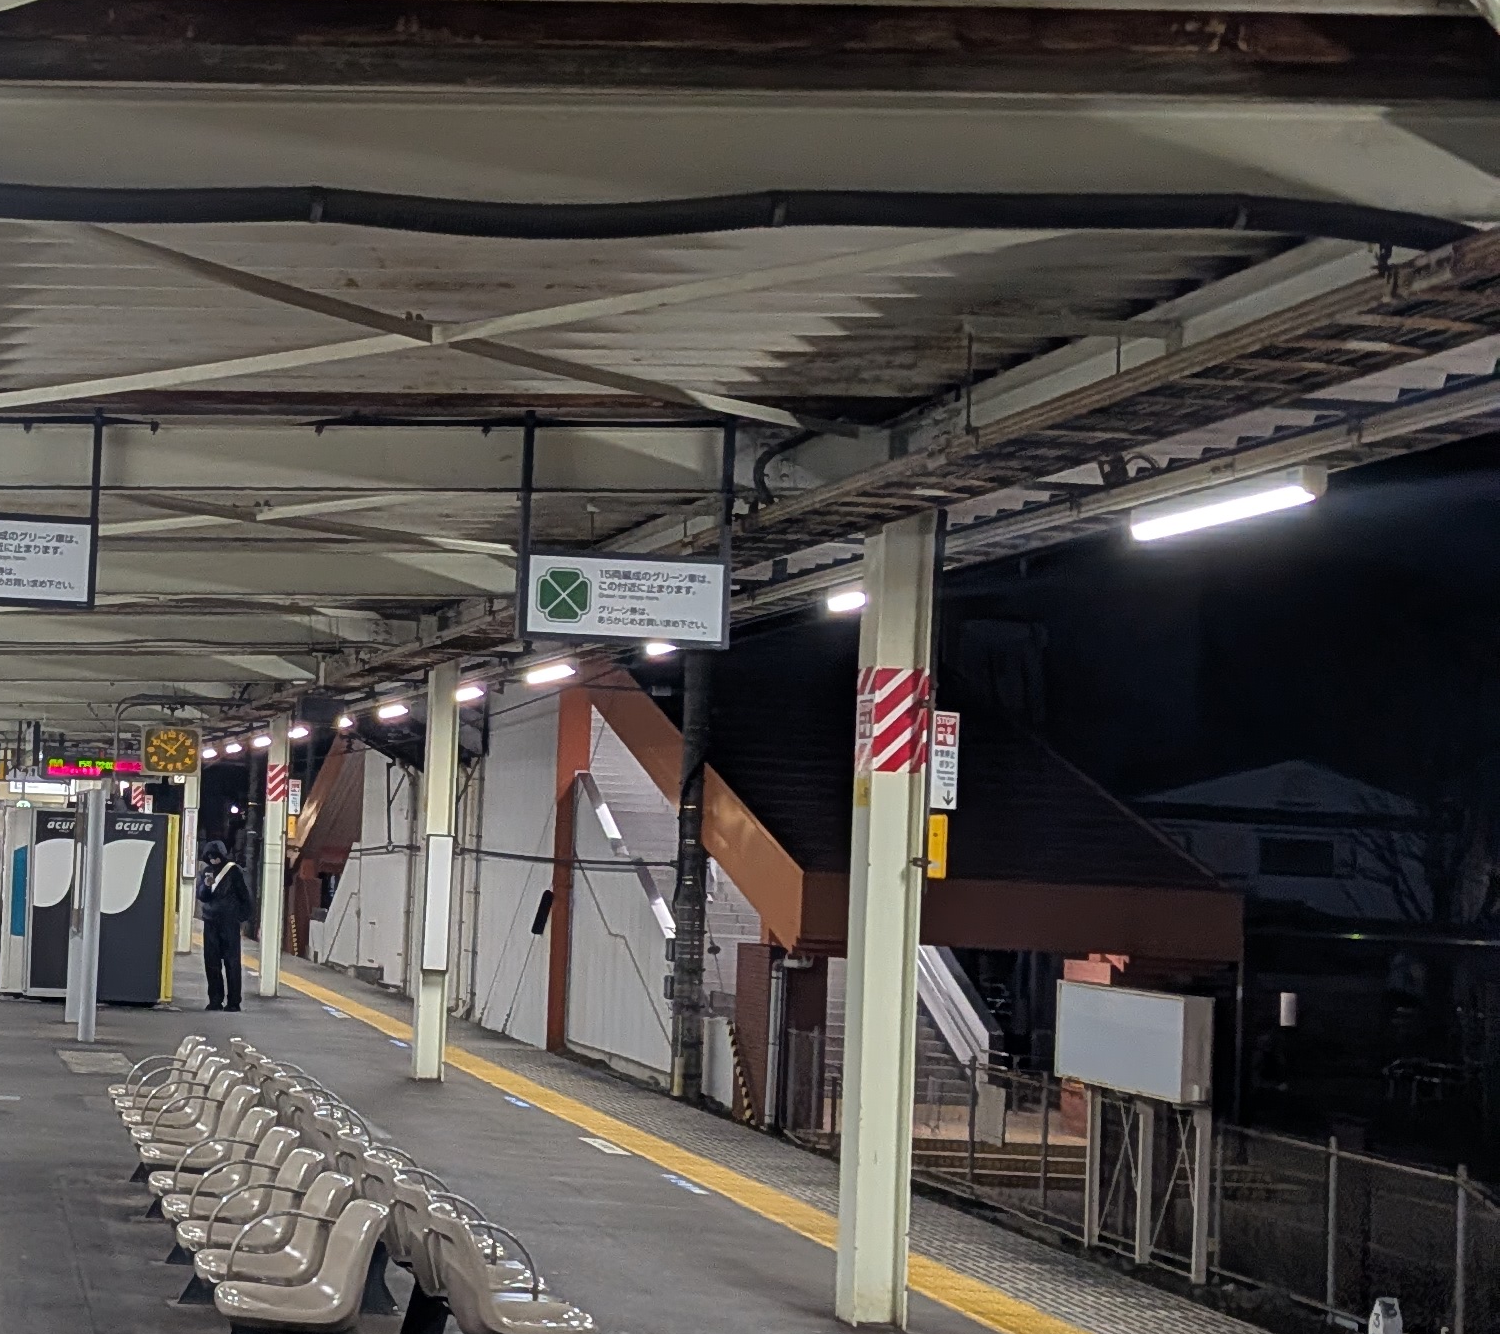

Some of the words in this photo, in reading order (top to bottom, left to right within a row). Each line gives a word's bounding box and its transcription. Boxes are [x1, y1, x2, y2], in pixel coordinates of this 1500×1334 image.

[599, 569, 712, 584] 15両編成のグリーン車は、
[598, 581, 697, 596] この付近に止まります。
[598, 605, 650, 616] グリーン券は、
[936, 716, 956, 726] STOP
[47, 821, 76, 829] acur
[115, 821, 153, 831] acure
